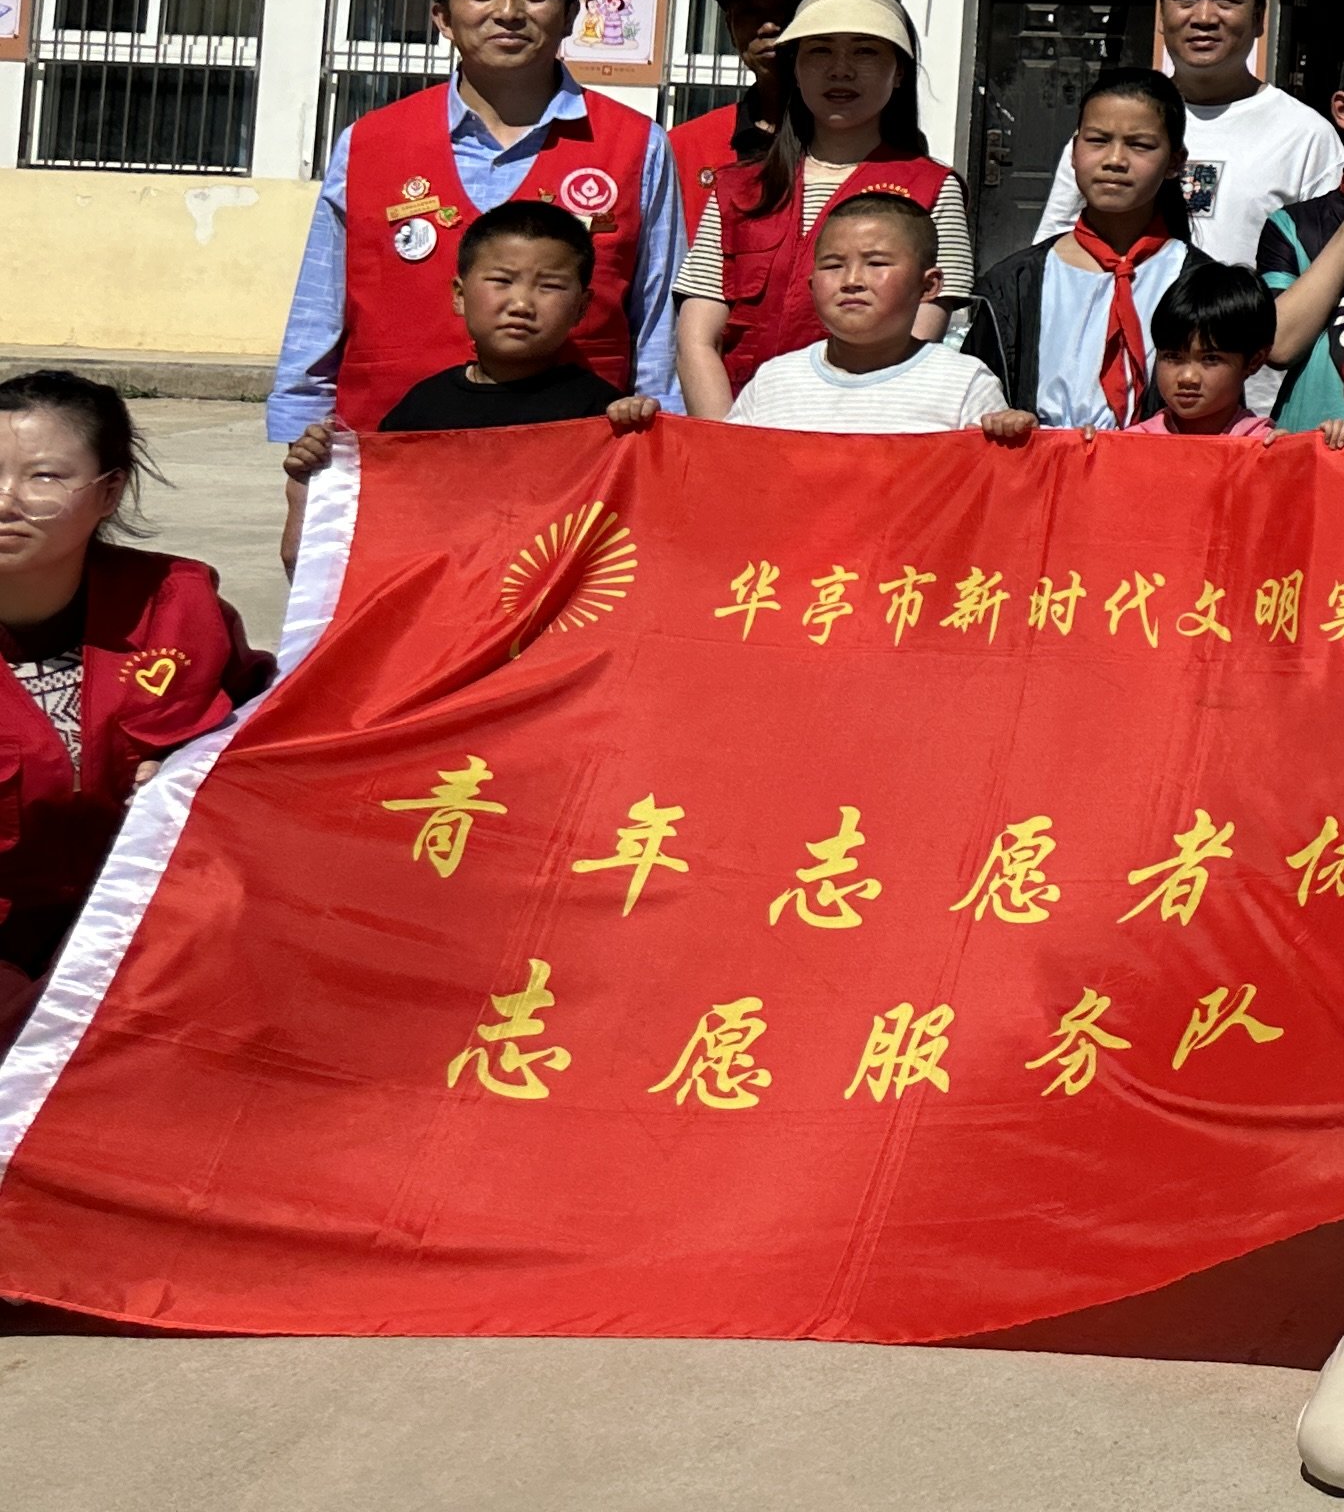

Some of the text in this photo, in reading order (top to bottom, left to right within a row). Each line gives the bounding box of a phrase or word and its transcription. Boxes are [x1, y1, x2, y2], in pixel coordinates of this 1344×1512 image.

[448, 958, 1284, 1109] 志愿服务队
